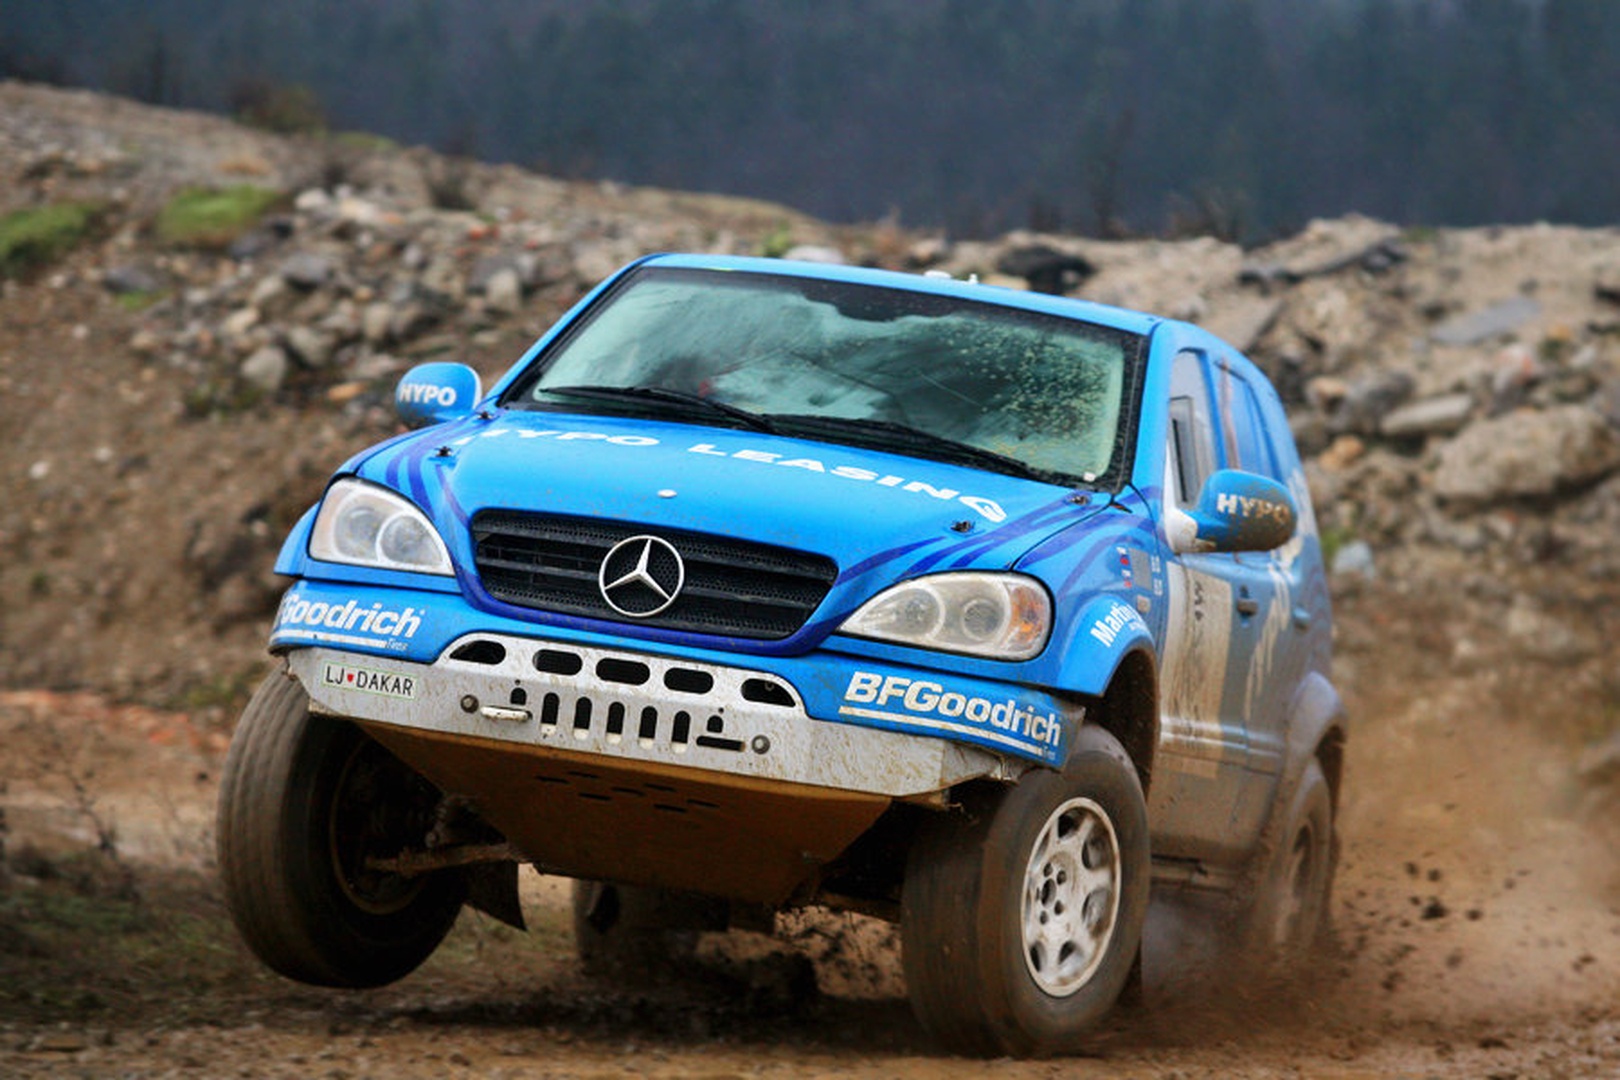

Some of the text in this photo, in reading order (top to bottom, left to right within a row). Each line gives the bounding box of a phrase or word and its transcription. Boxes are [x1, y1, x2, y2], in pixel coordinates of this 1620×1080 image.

[400, 384, 457, 407] HYPO
[687, 443, 1008, 524] LEASING
[1217, 493, 1290, 526] HYPO
[325, 665, 414, 697] LJ DAKAR
[843, 671, 1062, 747] BFGoodrich
